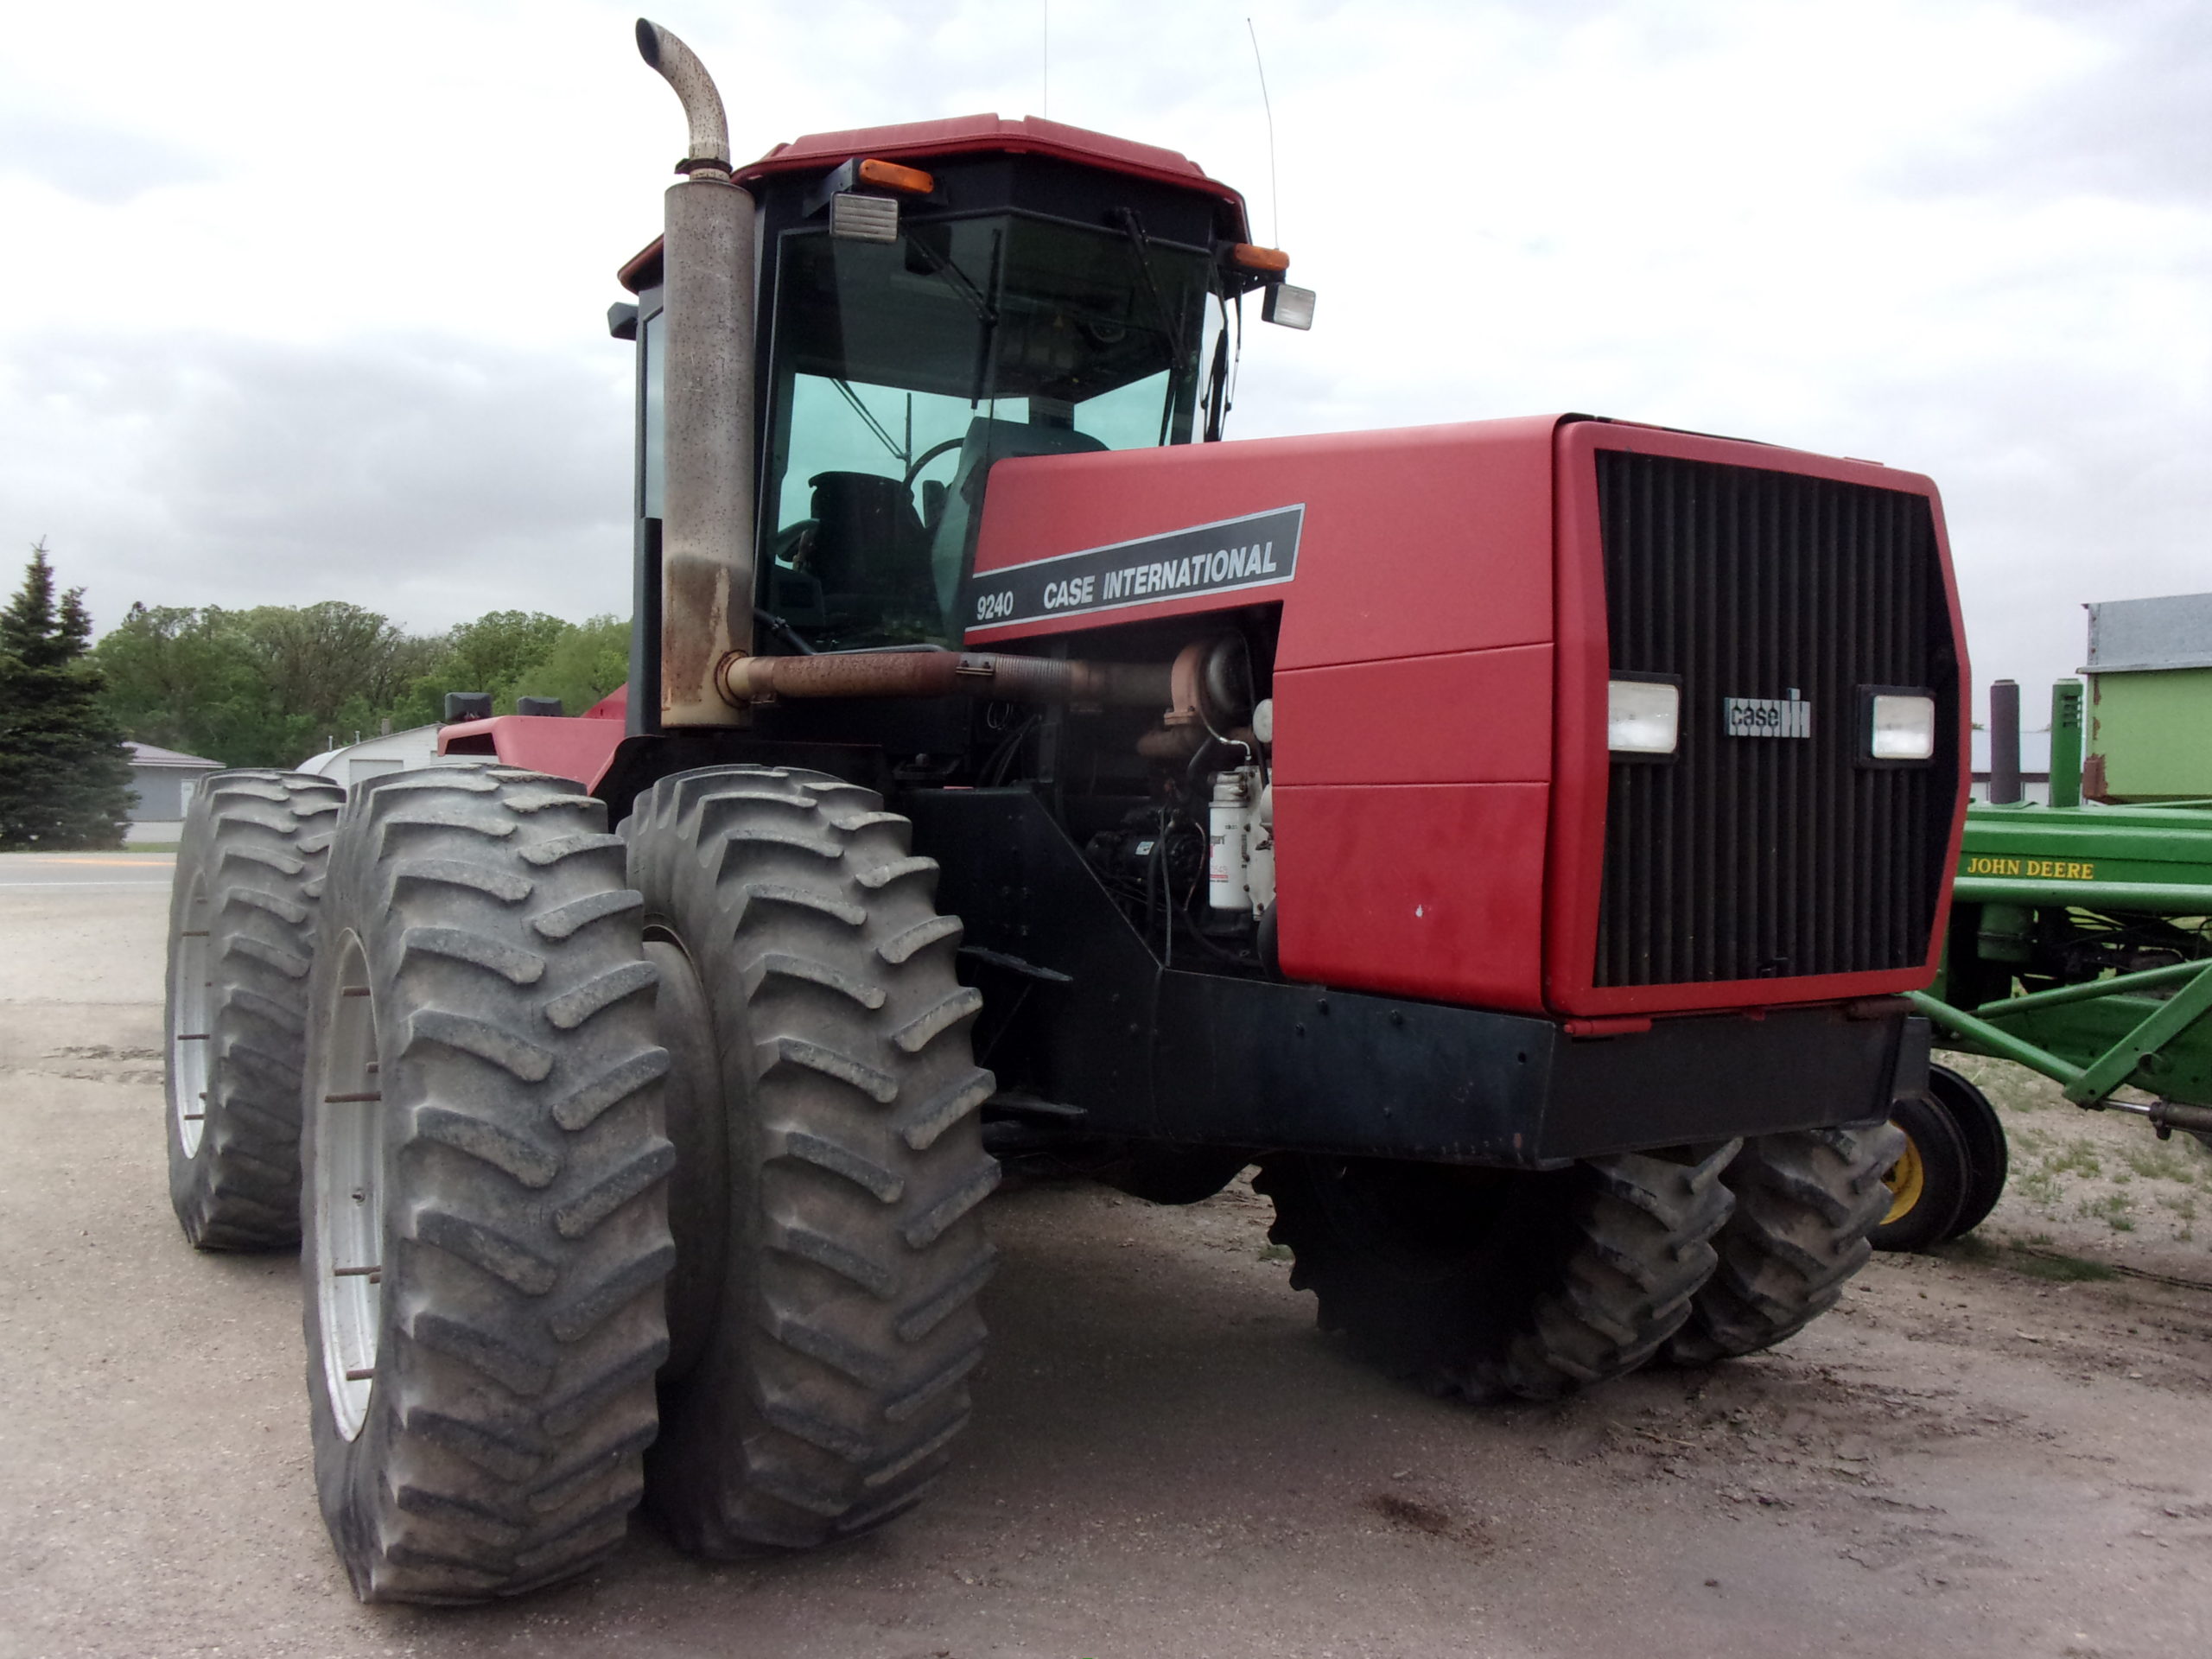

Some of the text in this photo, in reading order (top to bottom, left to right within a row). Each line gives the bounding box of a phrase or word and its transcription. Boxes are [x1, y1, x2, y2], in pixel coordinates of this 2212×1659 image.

[977, 542, 1277, 620] 9240 CASE INTERNATIONAL
[1967, 857, 2094, 880] JOHN DEERE
